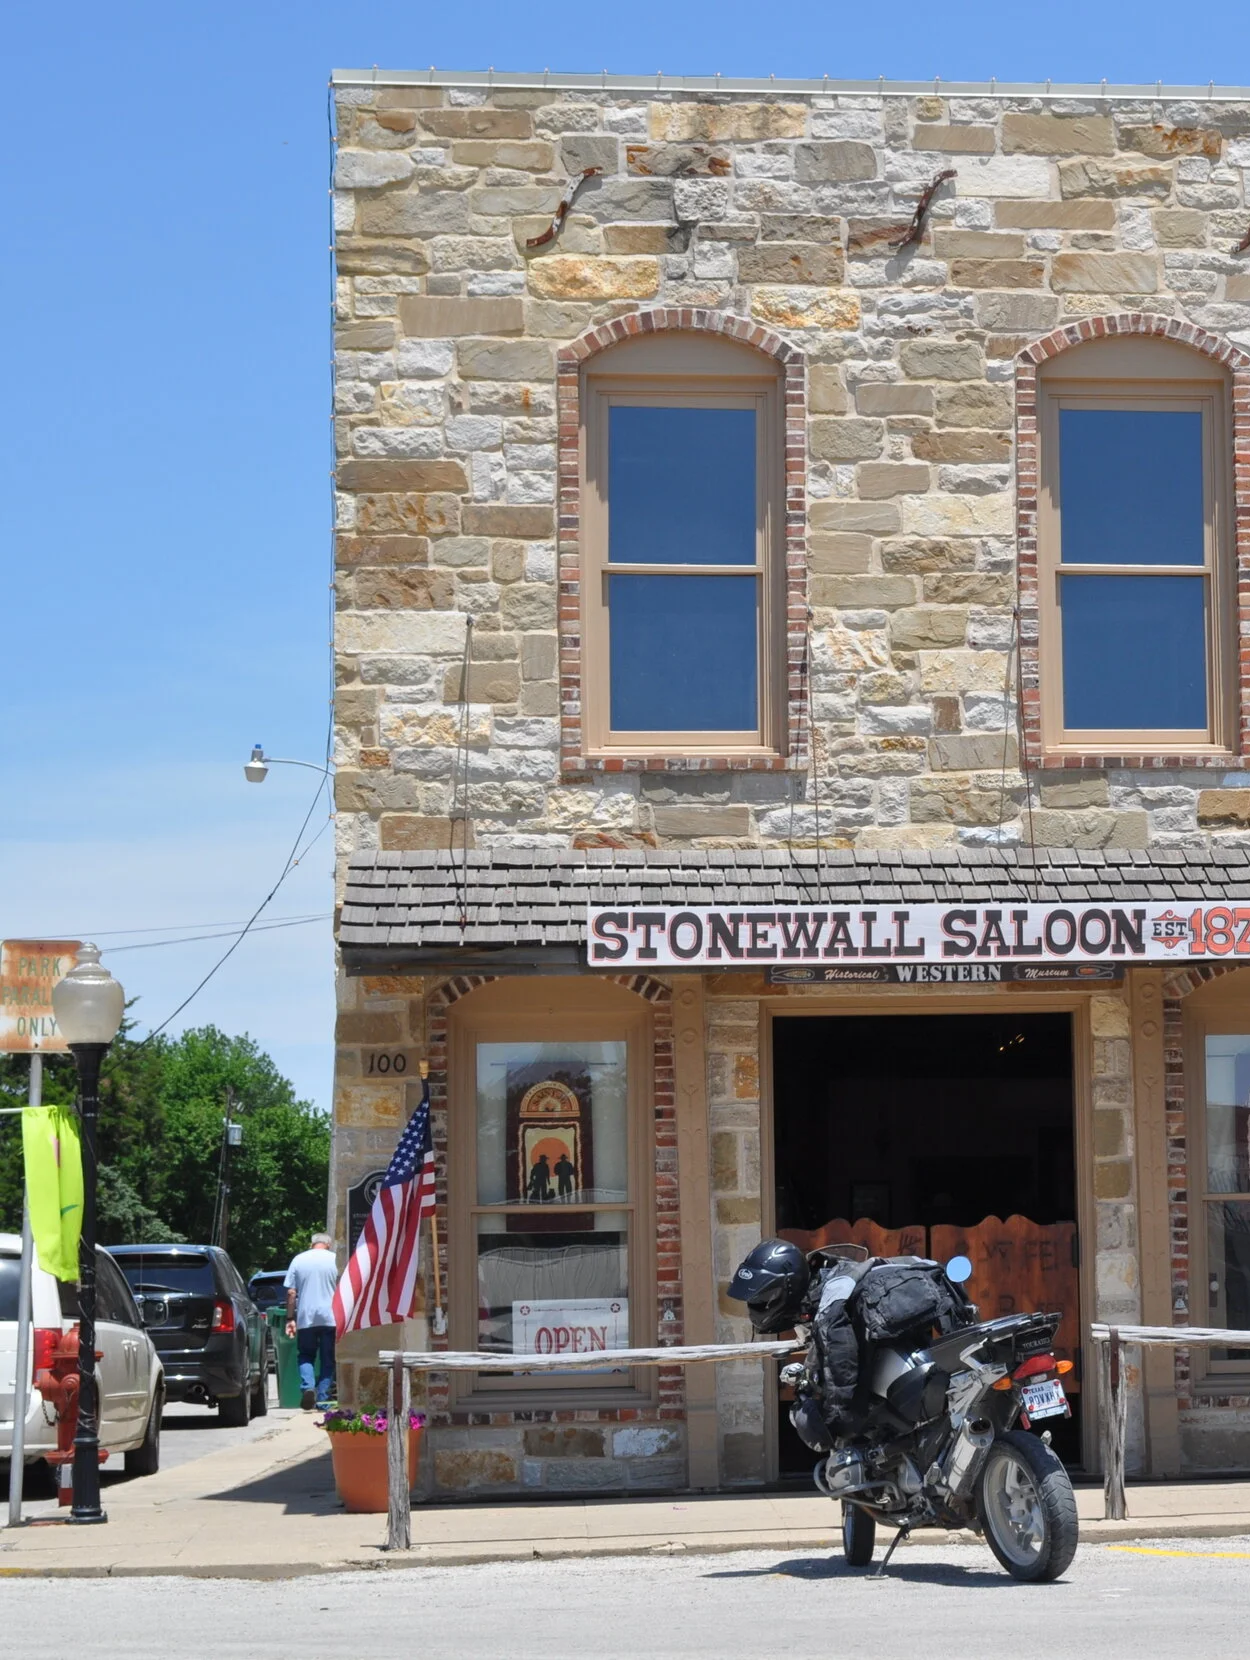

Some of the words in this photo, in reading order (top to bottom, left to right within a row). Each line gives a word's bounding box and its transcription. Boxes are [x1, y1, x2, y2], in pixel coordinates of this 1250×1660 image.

[592, 911, 925, 961] STONEWALL
[940, 908, 1146, 959] SALOON
[18, 957, 61, 976] PARK
[824, 967, 880, 980] Historical
[895, 964, 1002, 982] WESTERN
[1024, 968, 1070, 979] Museum
[17, 1016, 57, 1037] ONLY
[368, 1053, 406, 1074] 100
[535, 1326, 608, 1354] OPEN
